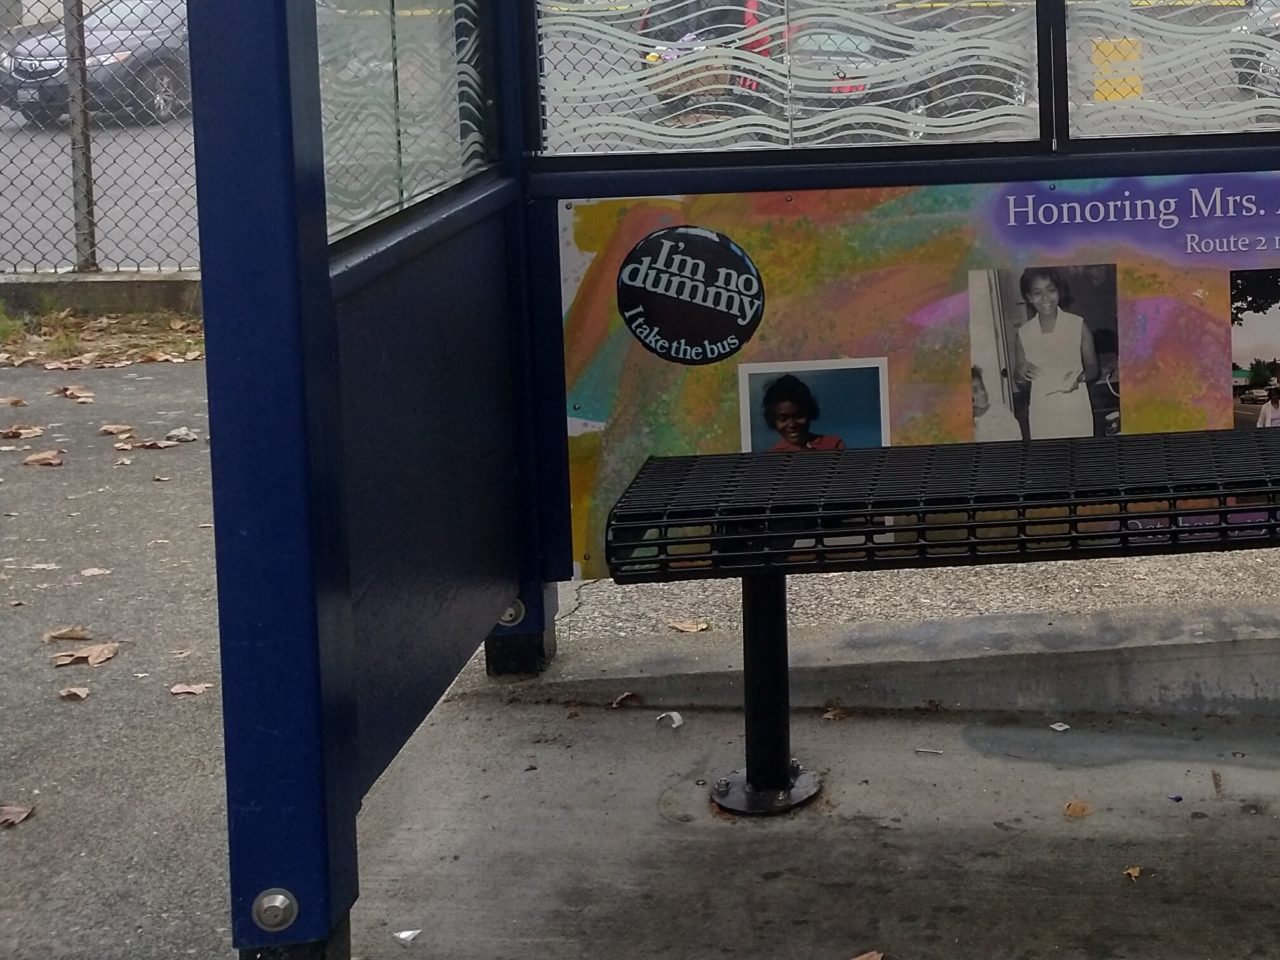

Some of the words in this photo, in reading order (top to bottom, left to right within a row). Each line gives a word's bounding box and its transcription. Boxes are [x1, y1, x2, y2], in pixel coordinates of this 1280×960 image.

[1006, 190, 1179, 229] Honoring
[1189, 187, 1265, 218] Mrs.
[1186, 233, 1249, 253] Route
[1255, 237, 1267, 250] 2
[651, 240, 706, 282] I'm
[714, 267, 759, 296] no
[622, 256, 761, 326] dummy
[624, 305, 645, 319] I
[631, 317, 669, 353] take
[670, 339, 702, 360] the
[704, 334, 739, 359] bus
